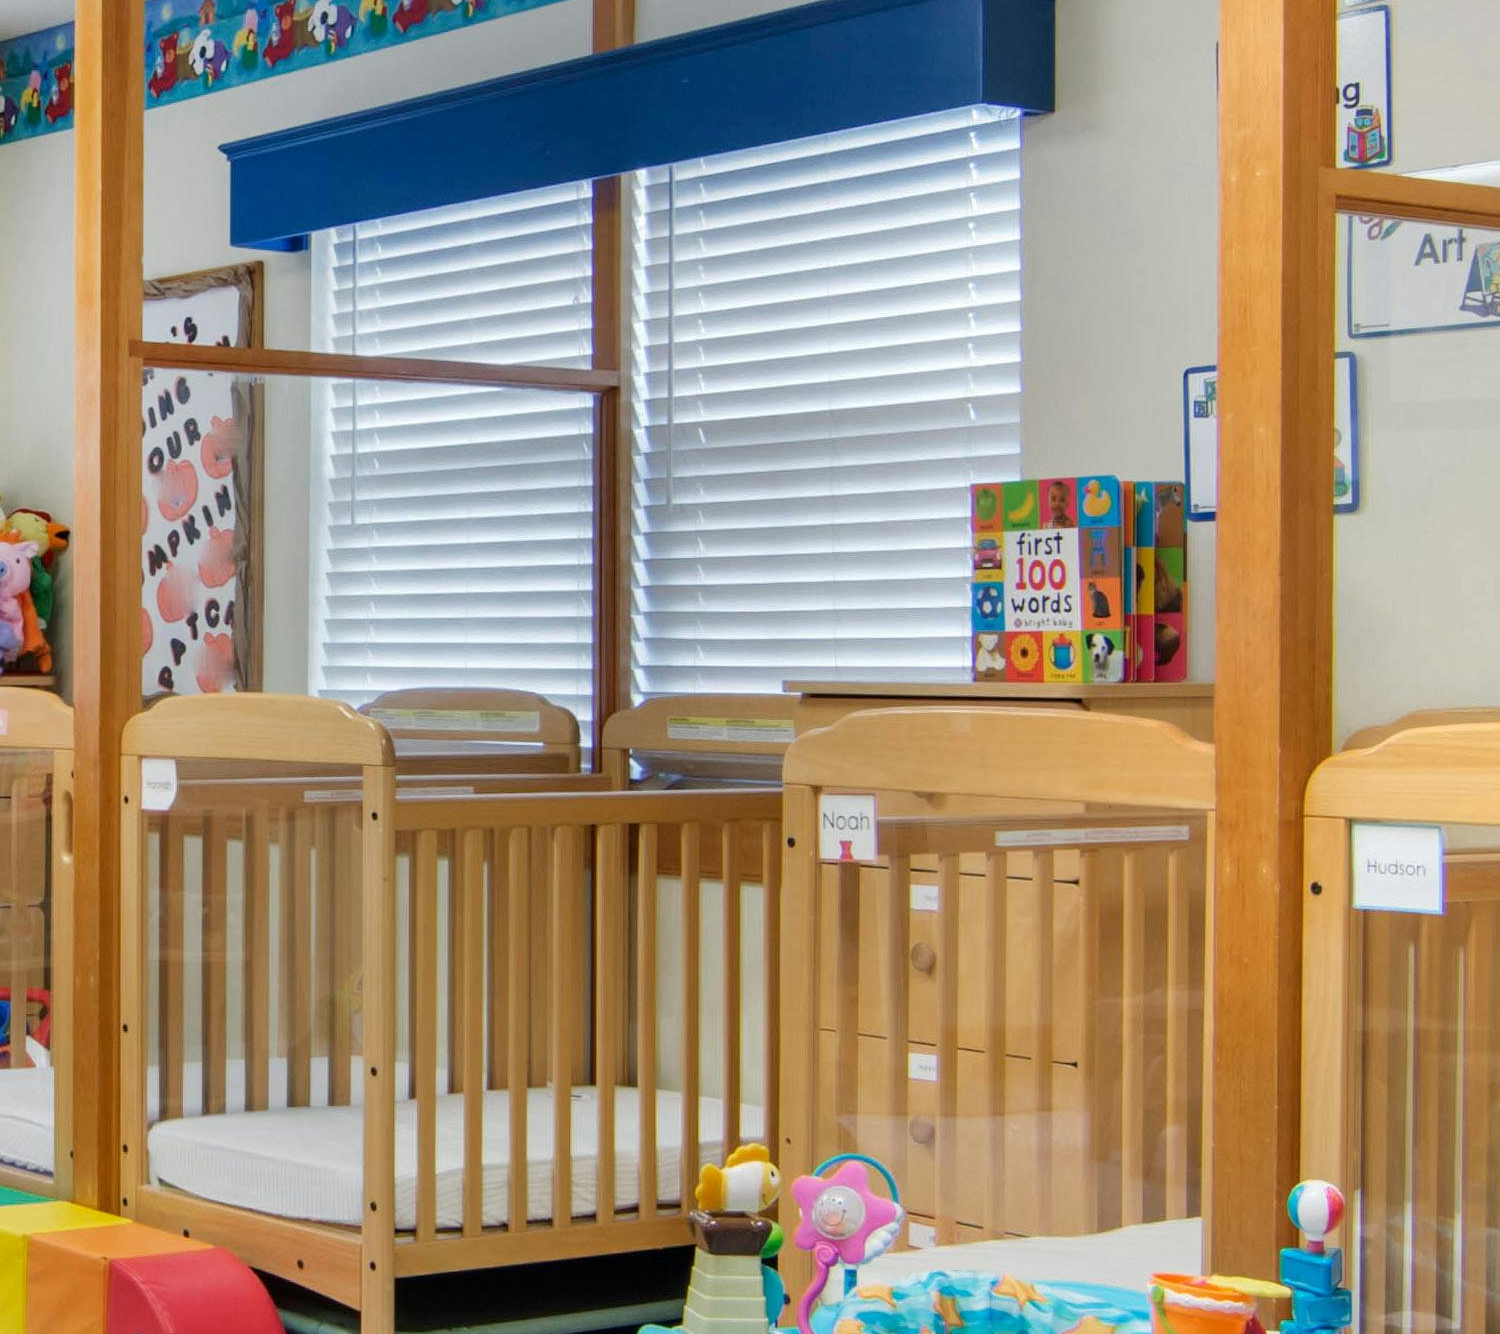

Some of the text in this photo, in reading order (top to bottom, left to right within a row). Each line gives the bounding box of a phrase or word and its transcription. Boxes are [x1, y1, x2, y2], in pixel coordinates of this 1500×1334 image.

[1414, 228, 1467, 267] Art
[143, 376, 191, 438] ING
[147, 418, 201, 474] OUR
[144, 483, 232, 577] MPKIN
[1016, 532, 1064, 556] first
[1015, 557, 1067, 591] 100
[1011, 593, 1073, 614] words
[822, 810, 870, 831] Noah
[1366, 858, 1426, 877] Hudson
